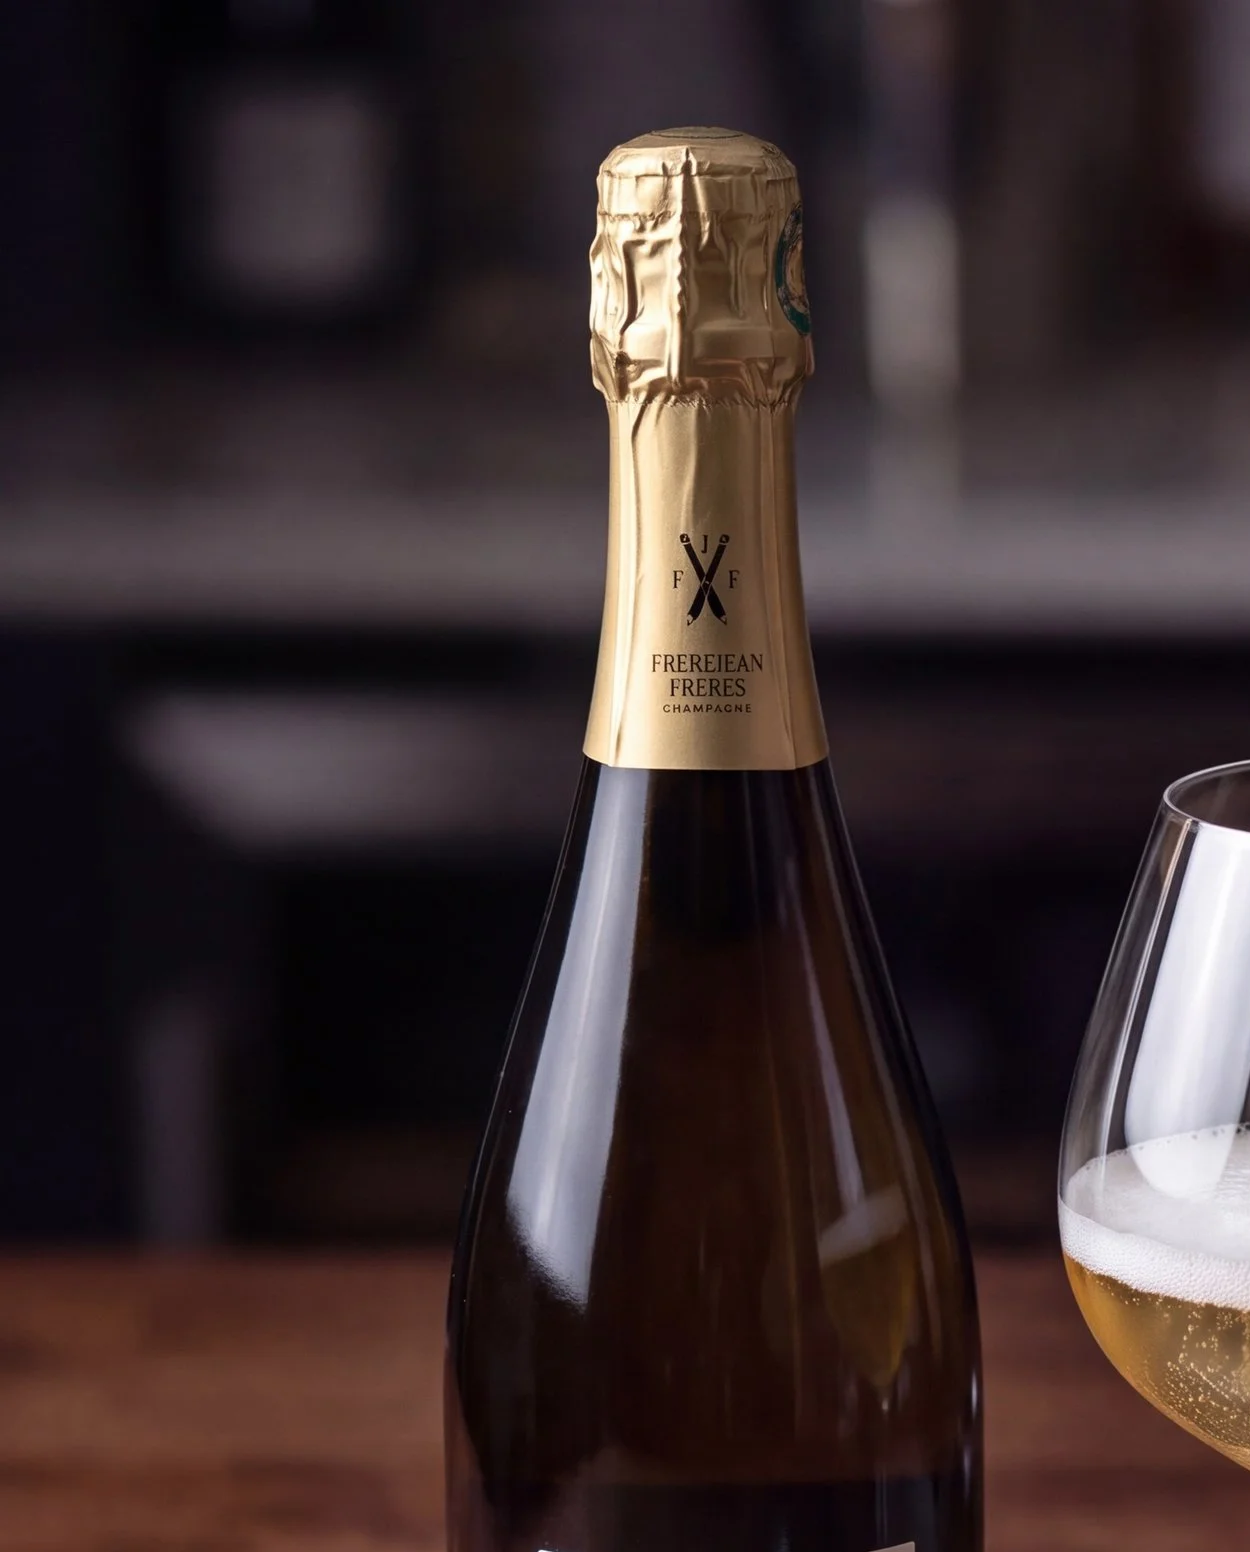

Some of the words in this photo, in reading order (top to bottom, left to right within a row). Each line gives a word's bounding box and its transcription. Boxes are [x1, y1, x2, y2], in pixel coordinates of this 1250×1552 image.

[701, 534, 709, 554] J
[672, 569, 684, 589] F
[728, 569, 741, 589] F
[670, 678, 746, 697] FRERES
